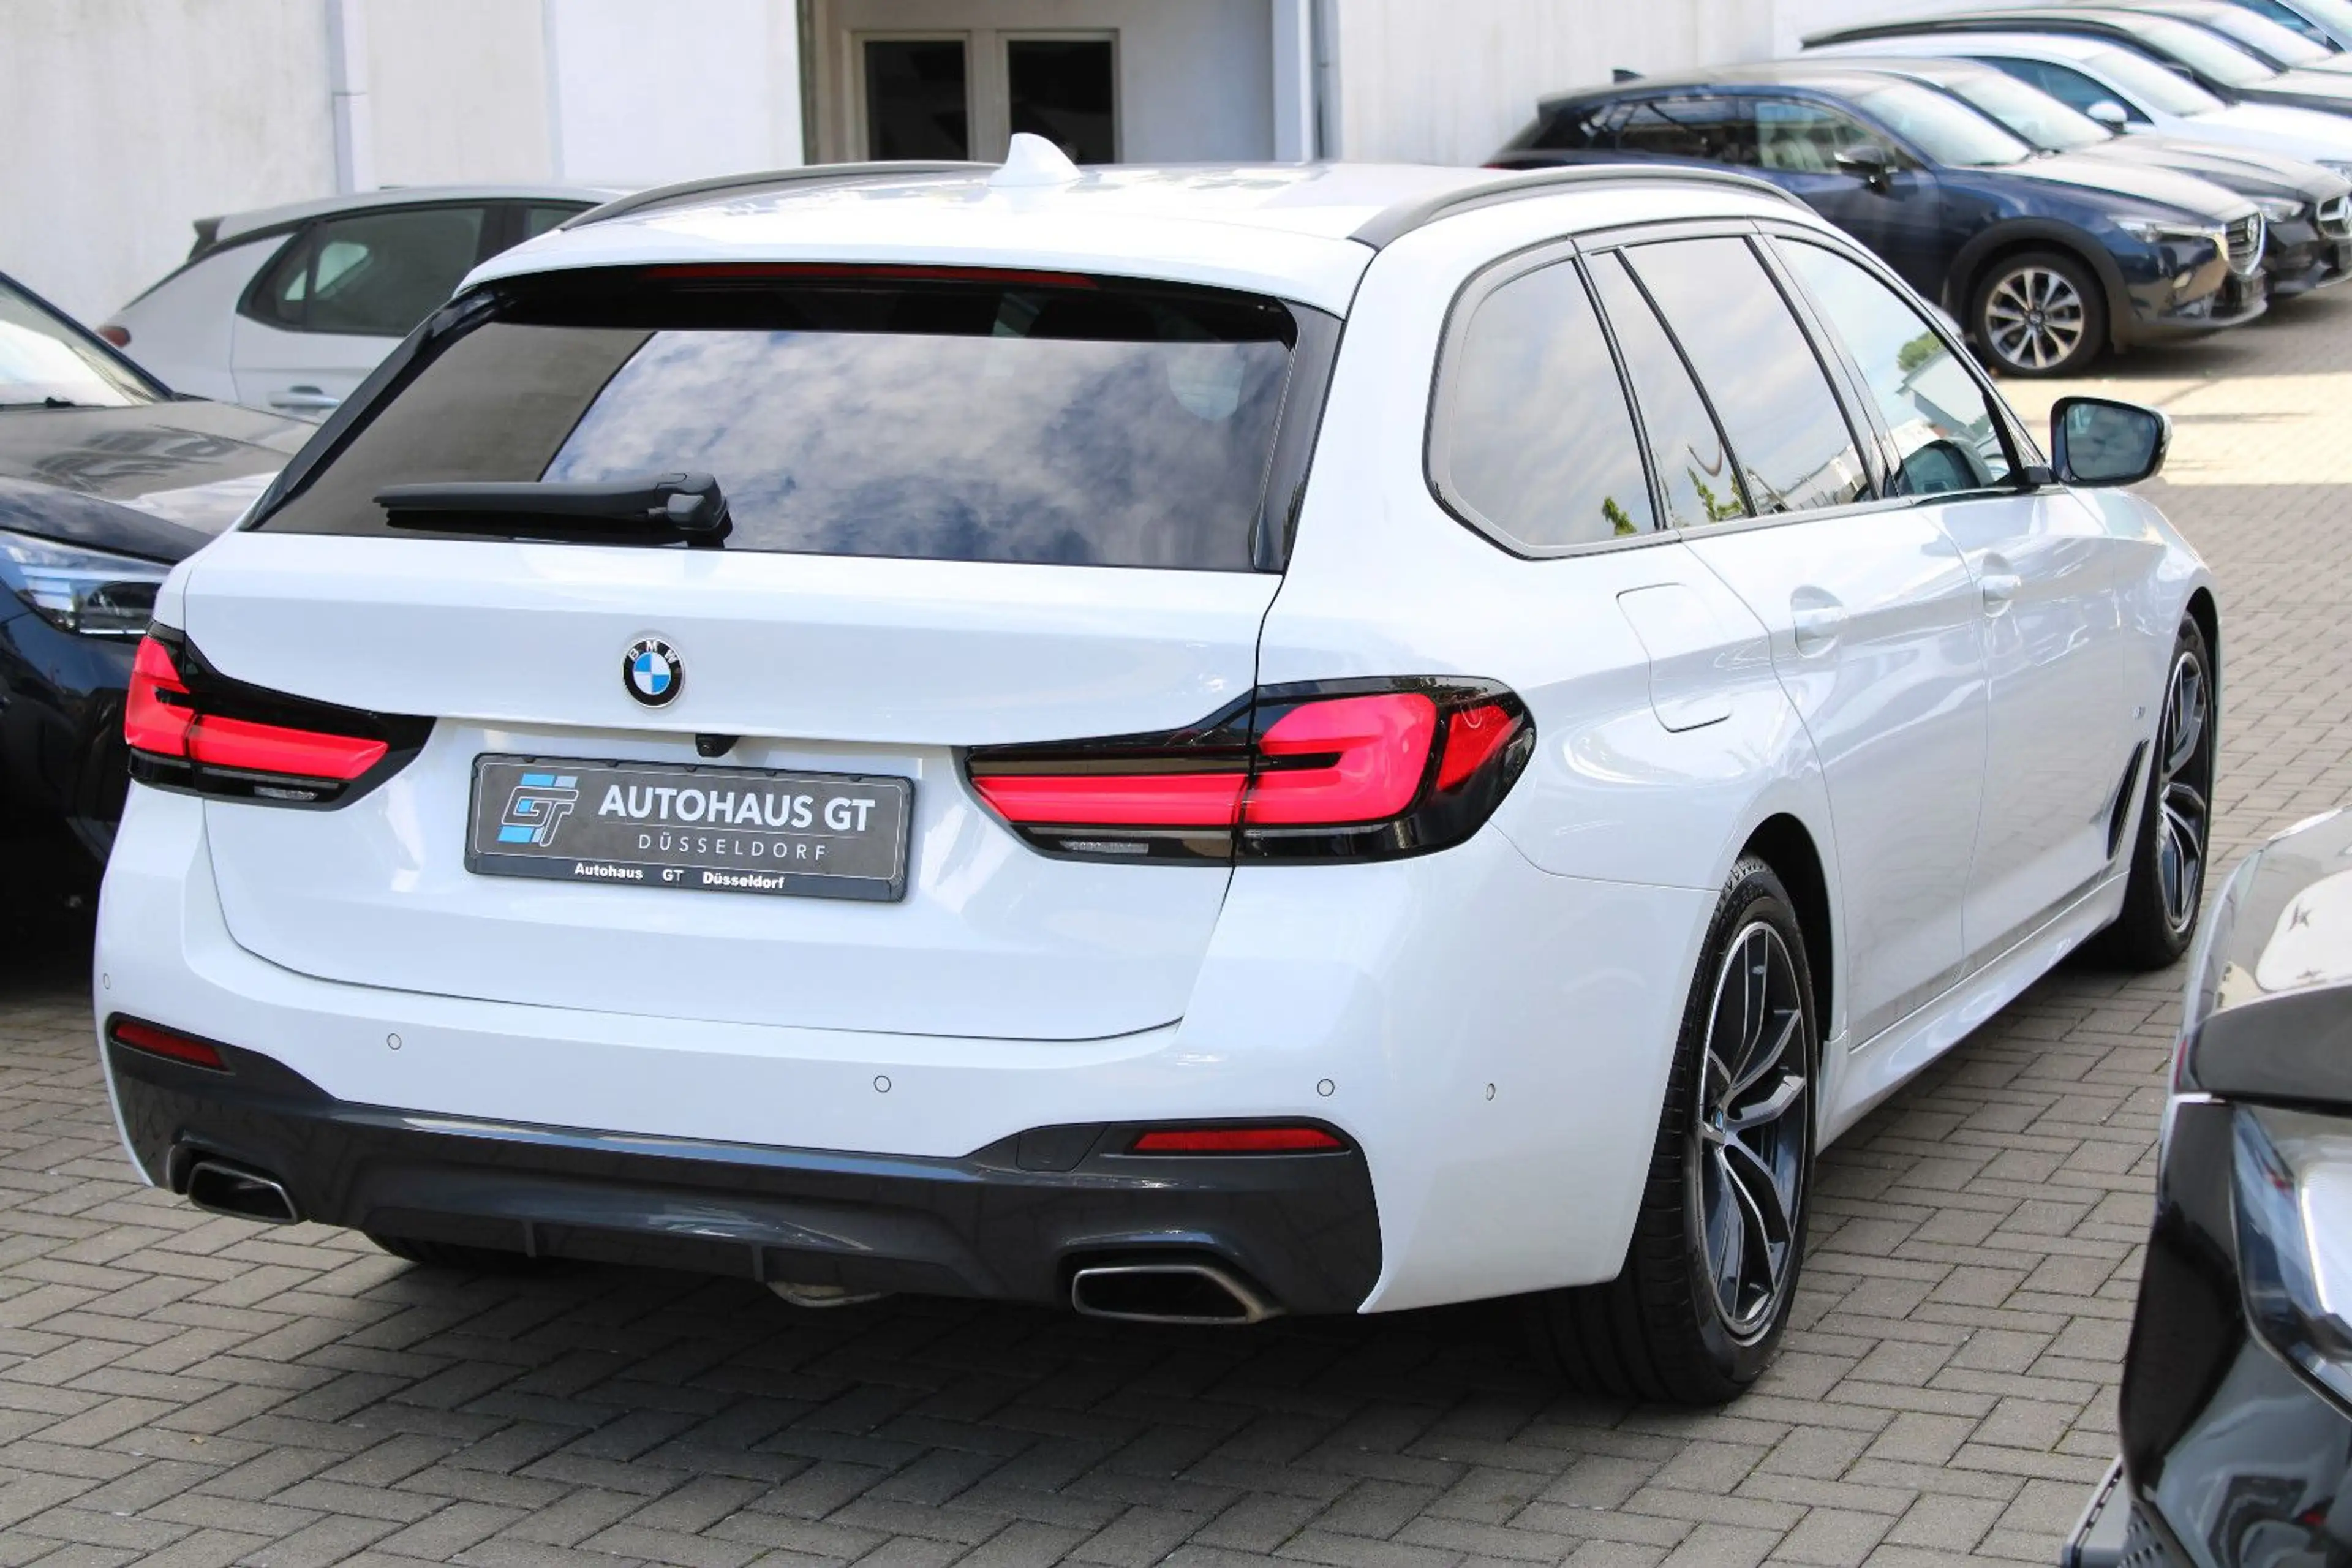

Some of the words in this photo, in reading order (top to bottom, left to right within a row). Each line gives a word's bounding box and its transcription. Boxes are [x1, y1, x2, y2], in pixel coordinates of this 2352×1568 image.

[628, 640, 679, 663] BMW
[598, 785, 814, 829] AUTOHAUS
[824, 797, 876, 832] GT
[638, 832, 827, 861] DÜSSELDORF
[575, 862, 644, 880] Autohaus
[662, 869, 685, 882] GT
[703, 870, 785, 889] Düsseldorf
